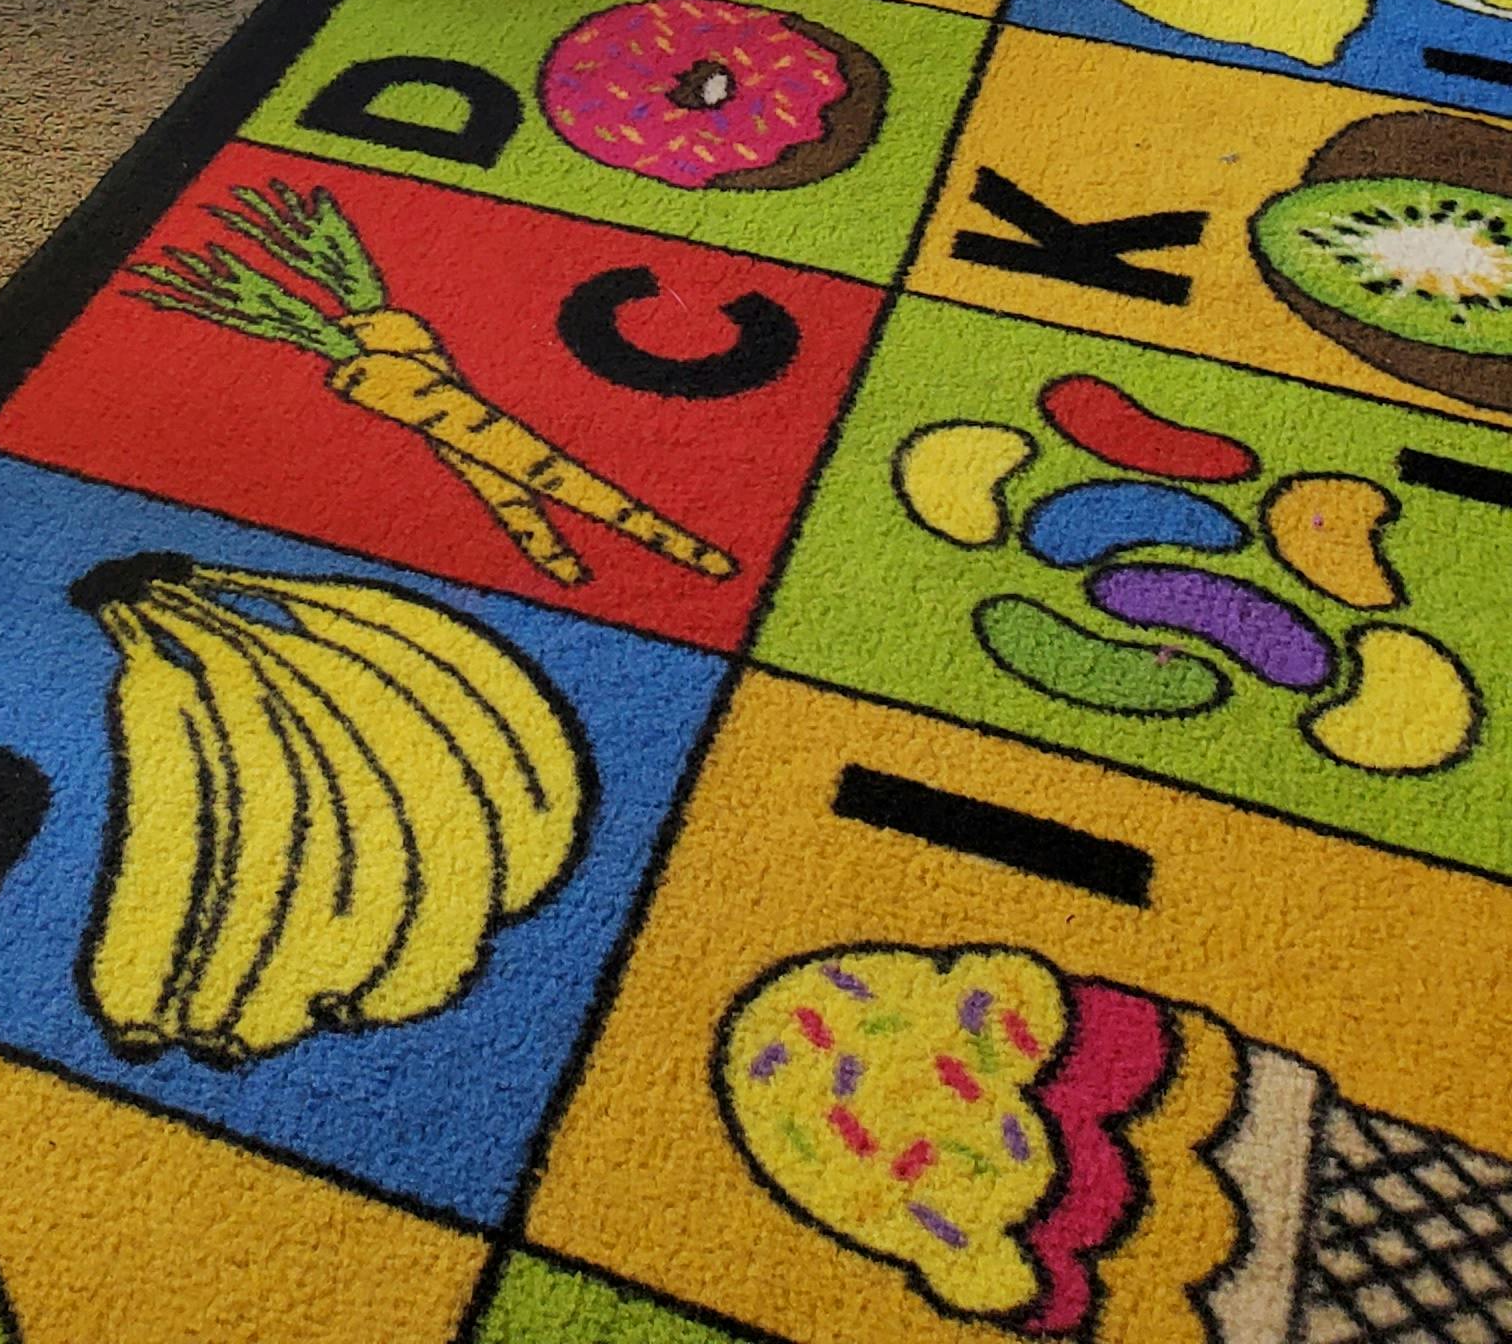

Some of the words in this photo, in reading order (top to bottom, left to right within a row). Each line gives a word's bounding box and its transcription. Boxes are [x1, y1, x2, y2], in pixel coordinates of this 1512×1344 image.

[295, 54, 525, 170] D
[949, 164, 1212, 307] K
[554, 263, 802, 400] C
